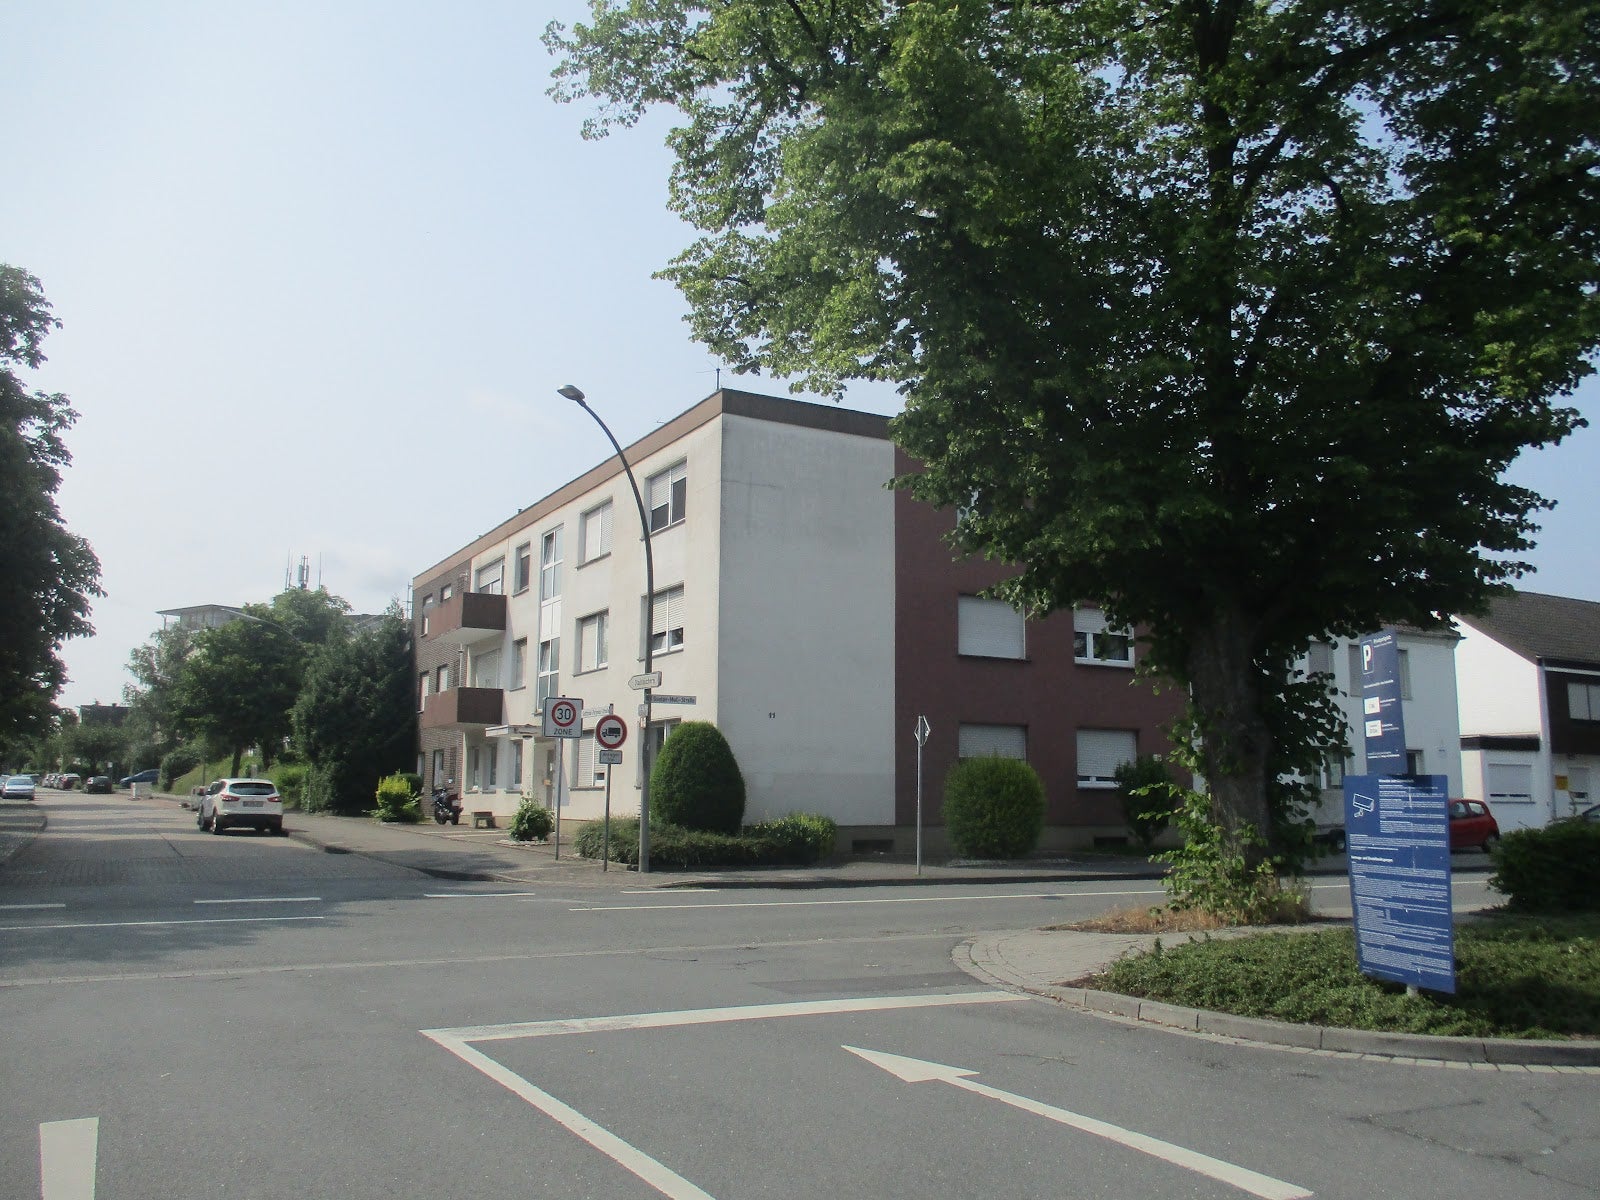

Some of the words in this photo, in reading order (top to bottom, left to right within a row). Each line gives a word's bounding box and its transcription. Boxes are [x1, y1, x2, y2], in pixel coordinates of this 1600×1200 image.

[1362, 644, 1372, 671] P
[556, 708, 572, 720] 30
[554, 728, 573, 736] ZONE
